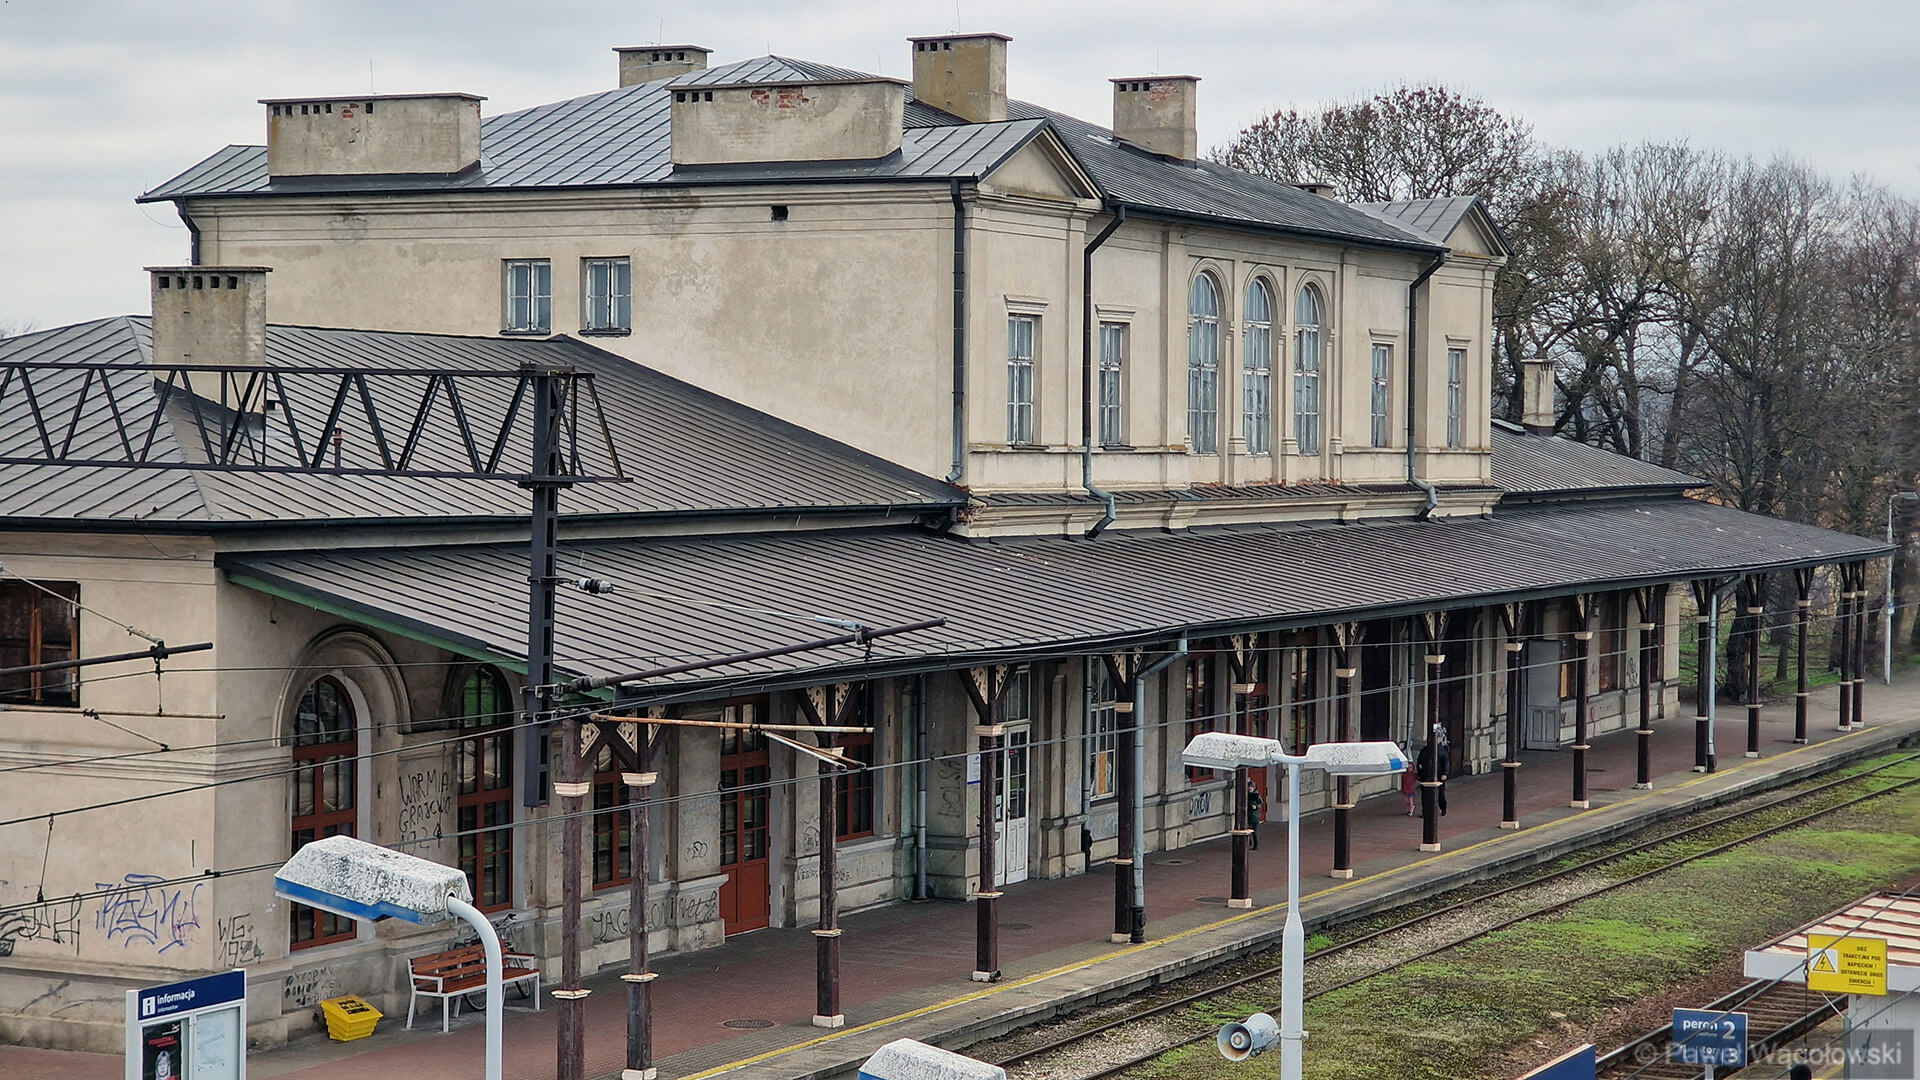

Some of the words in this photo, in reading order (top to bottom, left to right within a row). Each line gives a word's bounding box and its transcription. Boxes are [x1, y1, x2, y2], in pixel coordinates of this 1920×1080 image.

[398, 768, 450, 807] WARMIA
[157, 988, 196, 1005] informacja
[1683, 1019, 1718, 1031] peron
[1722, 1020, 1736, 1040] 2
[1680, 1044, 1688, 1062] 1
[1701, 1045, 1717, 1055] tor
[1727, 1047, 1739, 1063] 3
